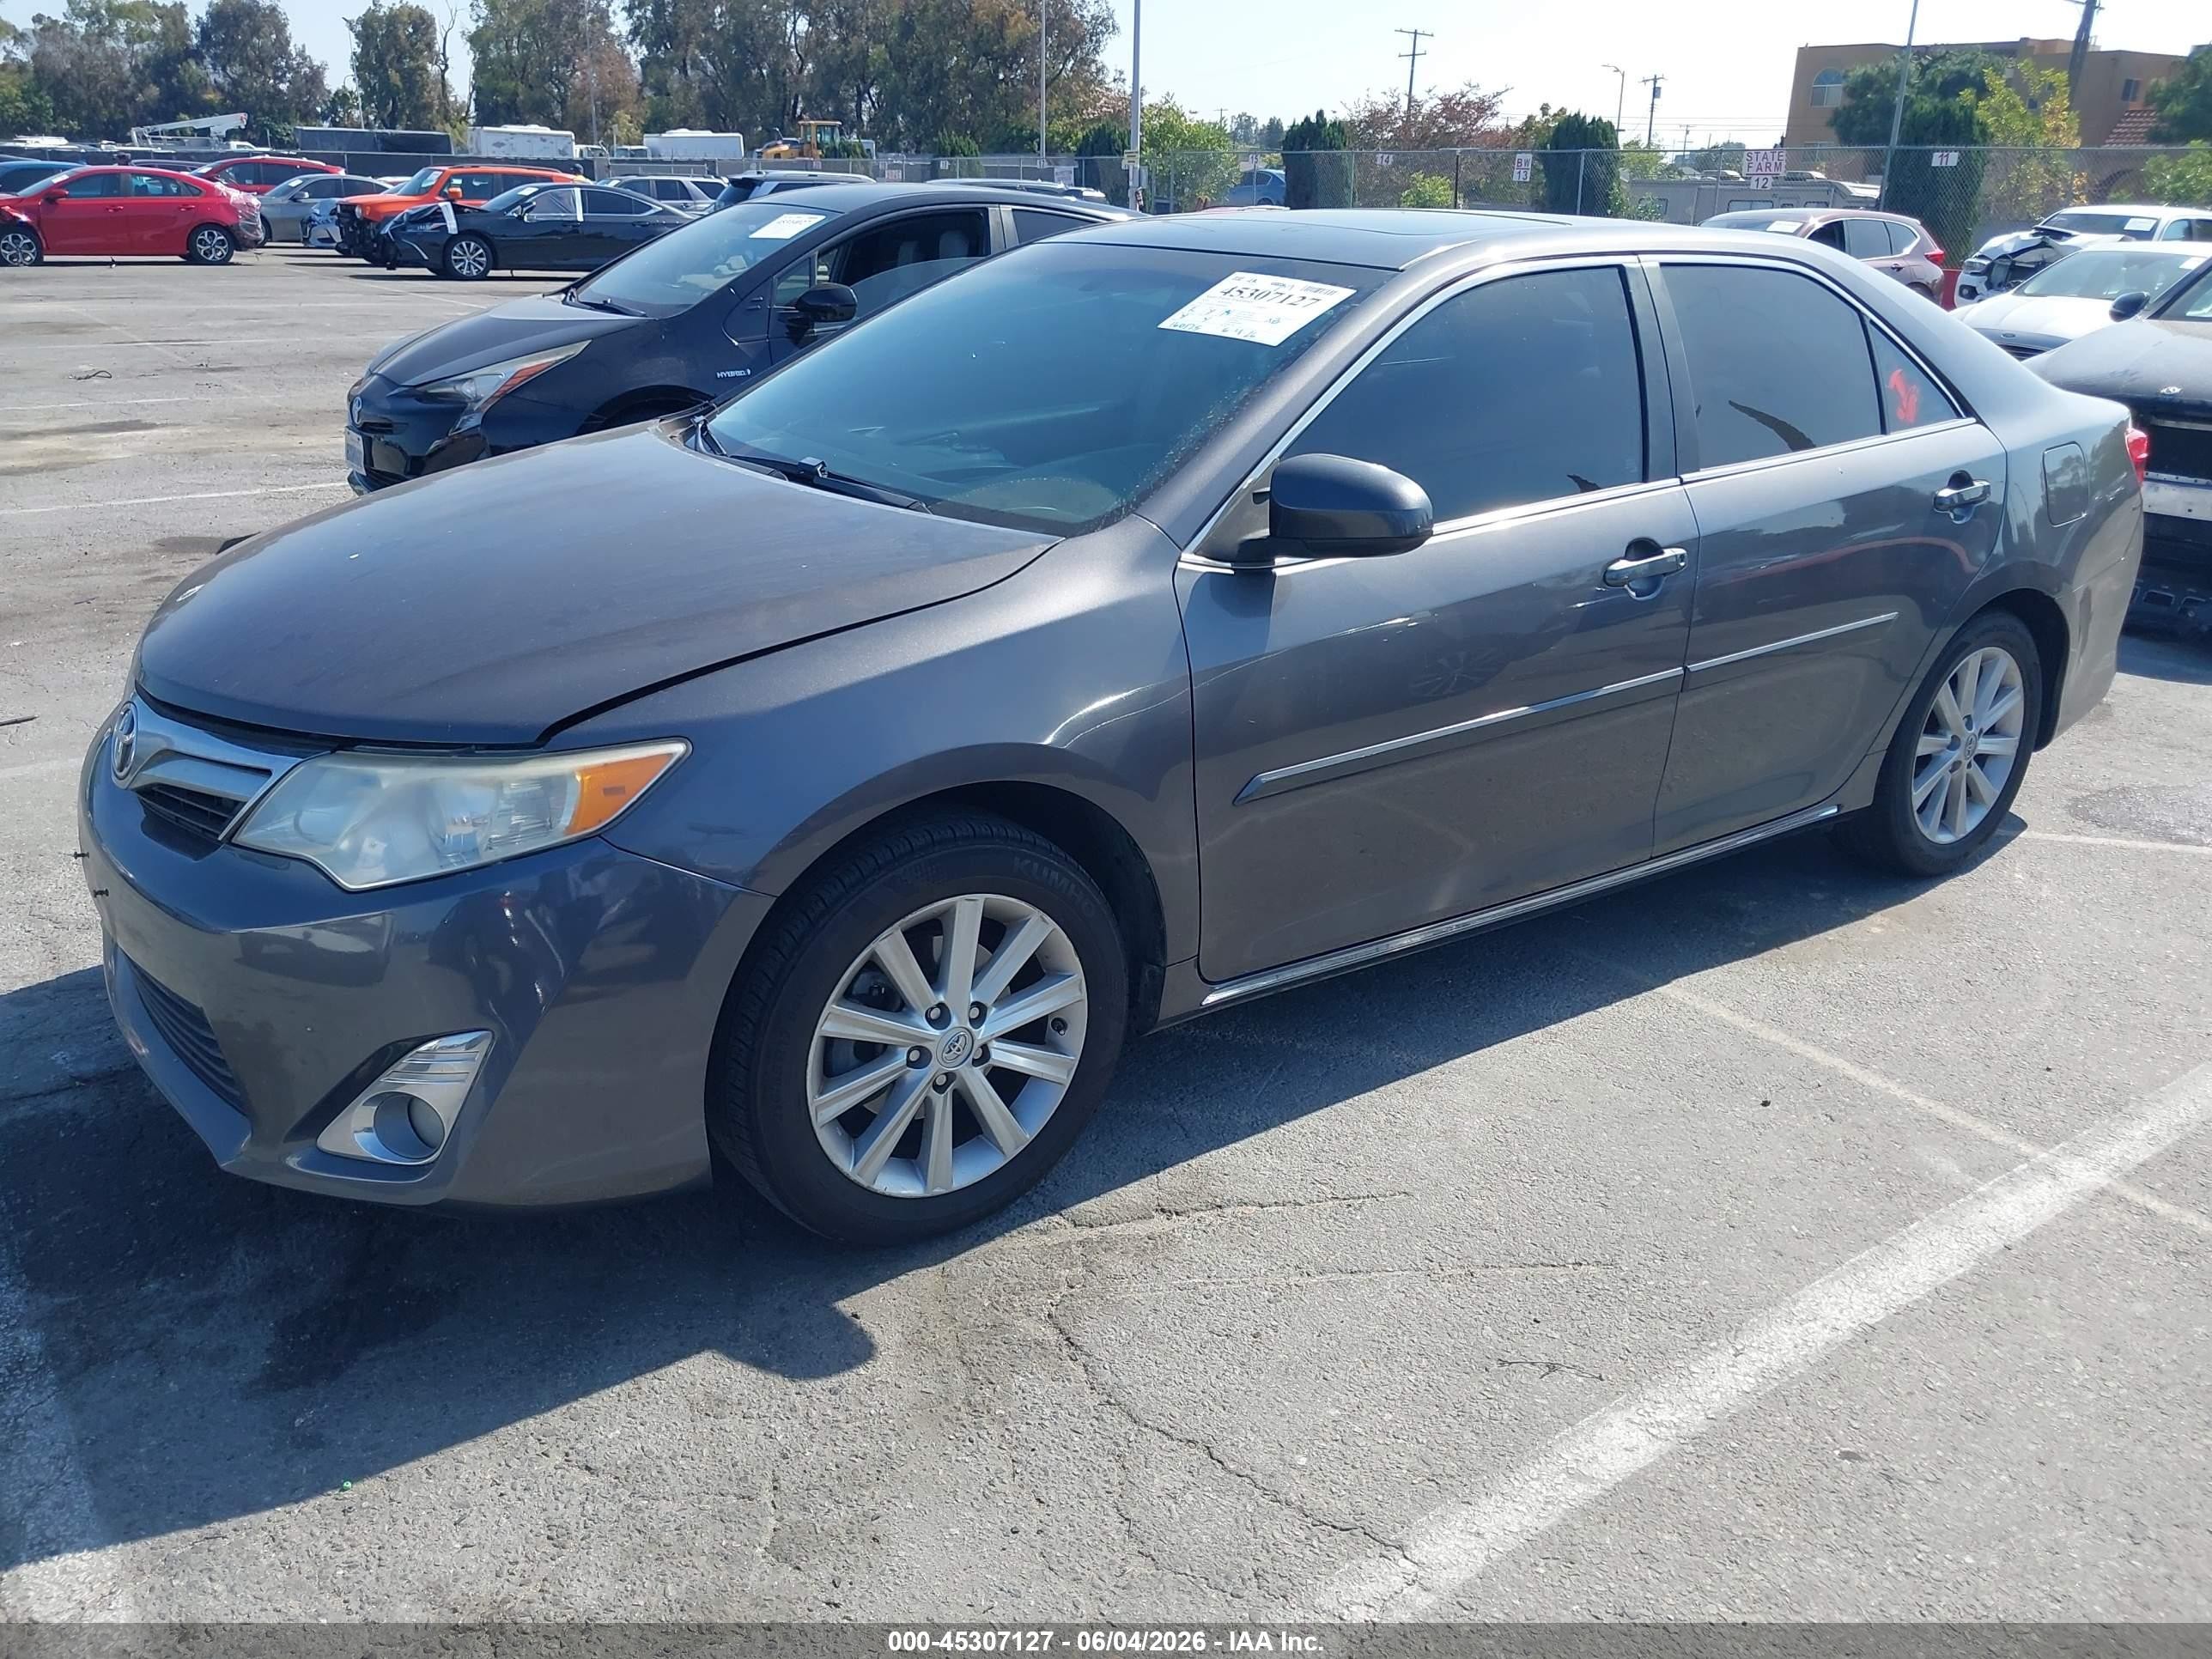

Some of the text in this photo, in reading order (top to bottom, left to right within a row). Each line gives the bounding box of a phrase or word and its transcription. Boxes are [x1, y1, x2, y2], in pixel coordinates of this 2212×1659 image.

[1380, 155, 1390, 164] 14
[1746, 150, 1784, 161] STATE
[1938, 153, 1950, 165] 11
[1516, 158, 1531, 167] BW
[1747, 162, 1782, 172] FARM
[1516, 170, 1528, 180] 13
[1754, 177, 1769, 189] 12
[1219, 286, 1322, 308] 45307127
[716, 369, 746, 379] HYBRID
[1011, 854, 1094, 919] KUMHO
